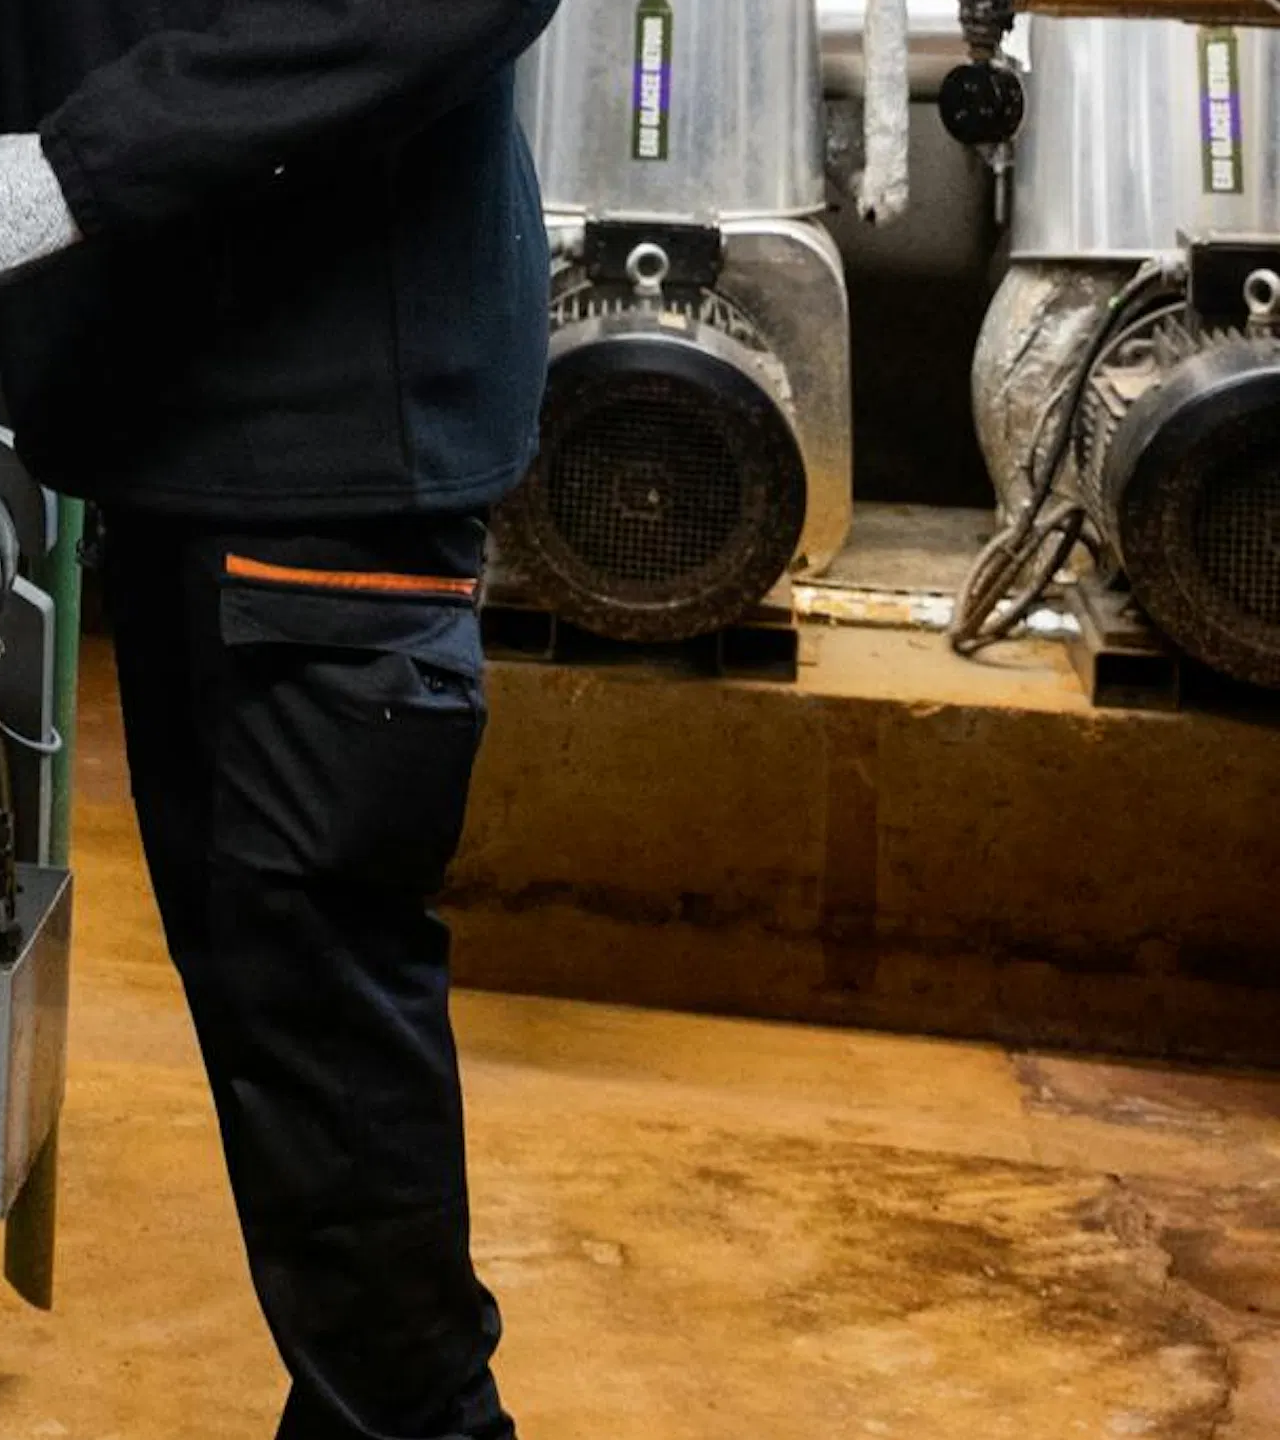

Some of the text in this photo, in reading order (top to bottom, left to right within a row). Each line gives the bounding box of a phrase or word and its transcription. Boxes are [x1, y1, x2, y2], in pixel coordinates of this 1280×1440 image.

[641, 16, 664, 71] RETOUR
[1207, 42, 1231, 99] RETOUR
[639, 126, 660, 157] EAU
[1211, 159, 1234, 190] EAU
